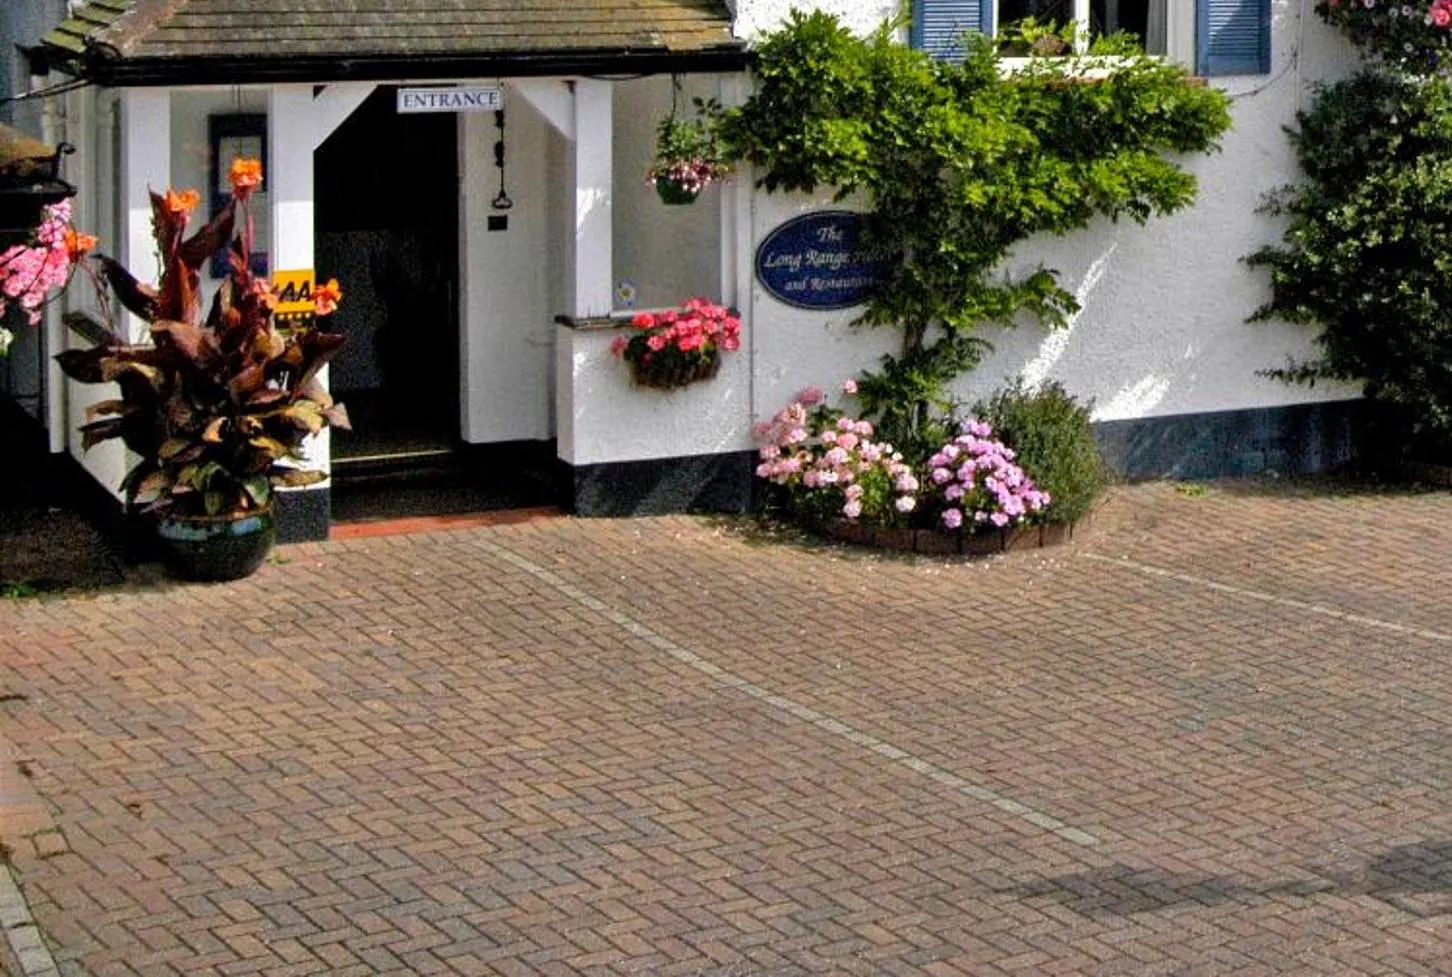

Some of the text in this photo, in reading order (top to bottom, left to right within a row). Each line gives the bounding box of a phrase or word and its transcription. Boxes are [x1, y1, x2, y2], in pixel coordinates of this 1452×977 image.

[403, 92, 498, 108] ENTRANCE
[817, 224, 842, 242] The
[764, 251, 802, 272] Long
[806, 247, 851, 271] Range
[278, 280, 312, 303] AA
[786, 276, 807, 291] and
